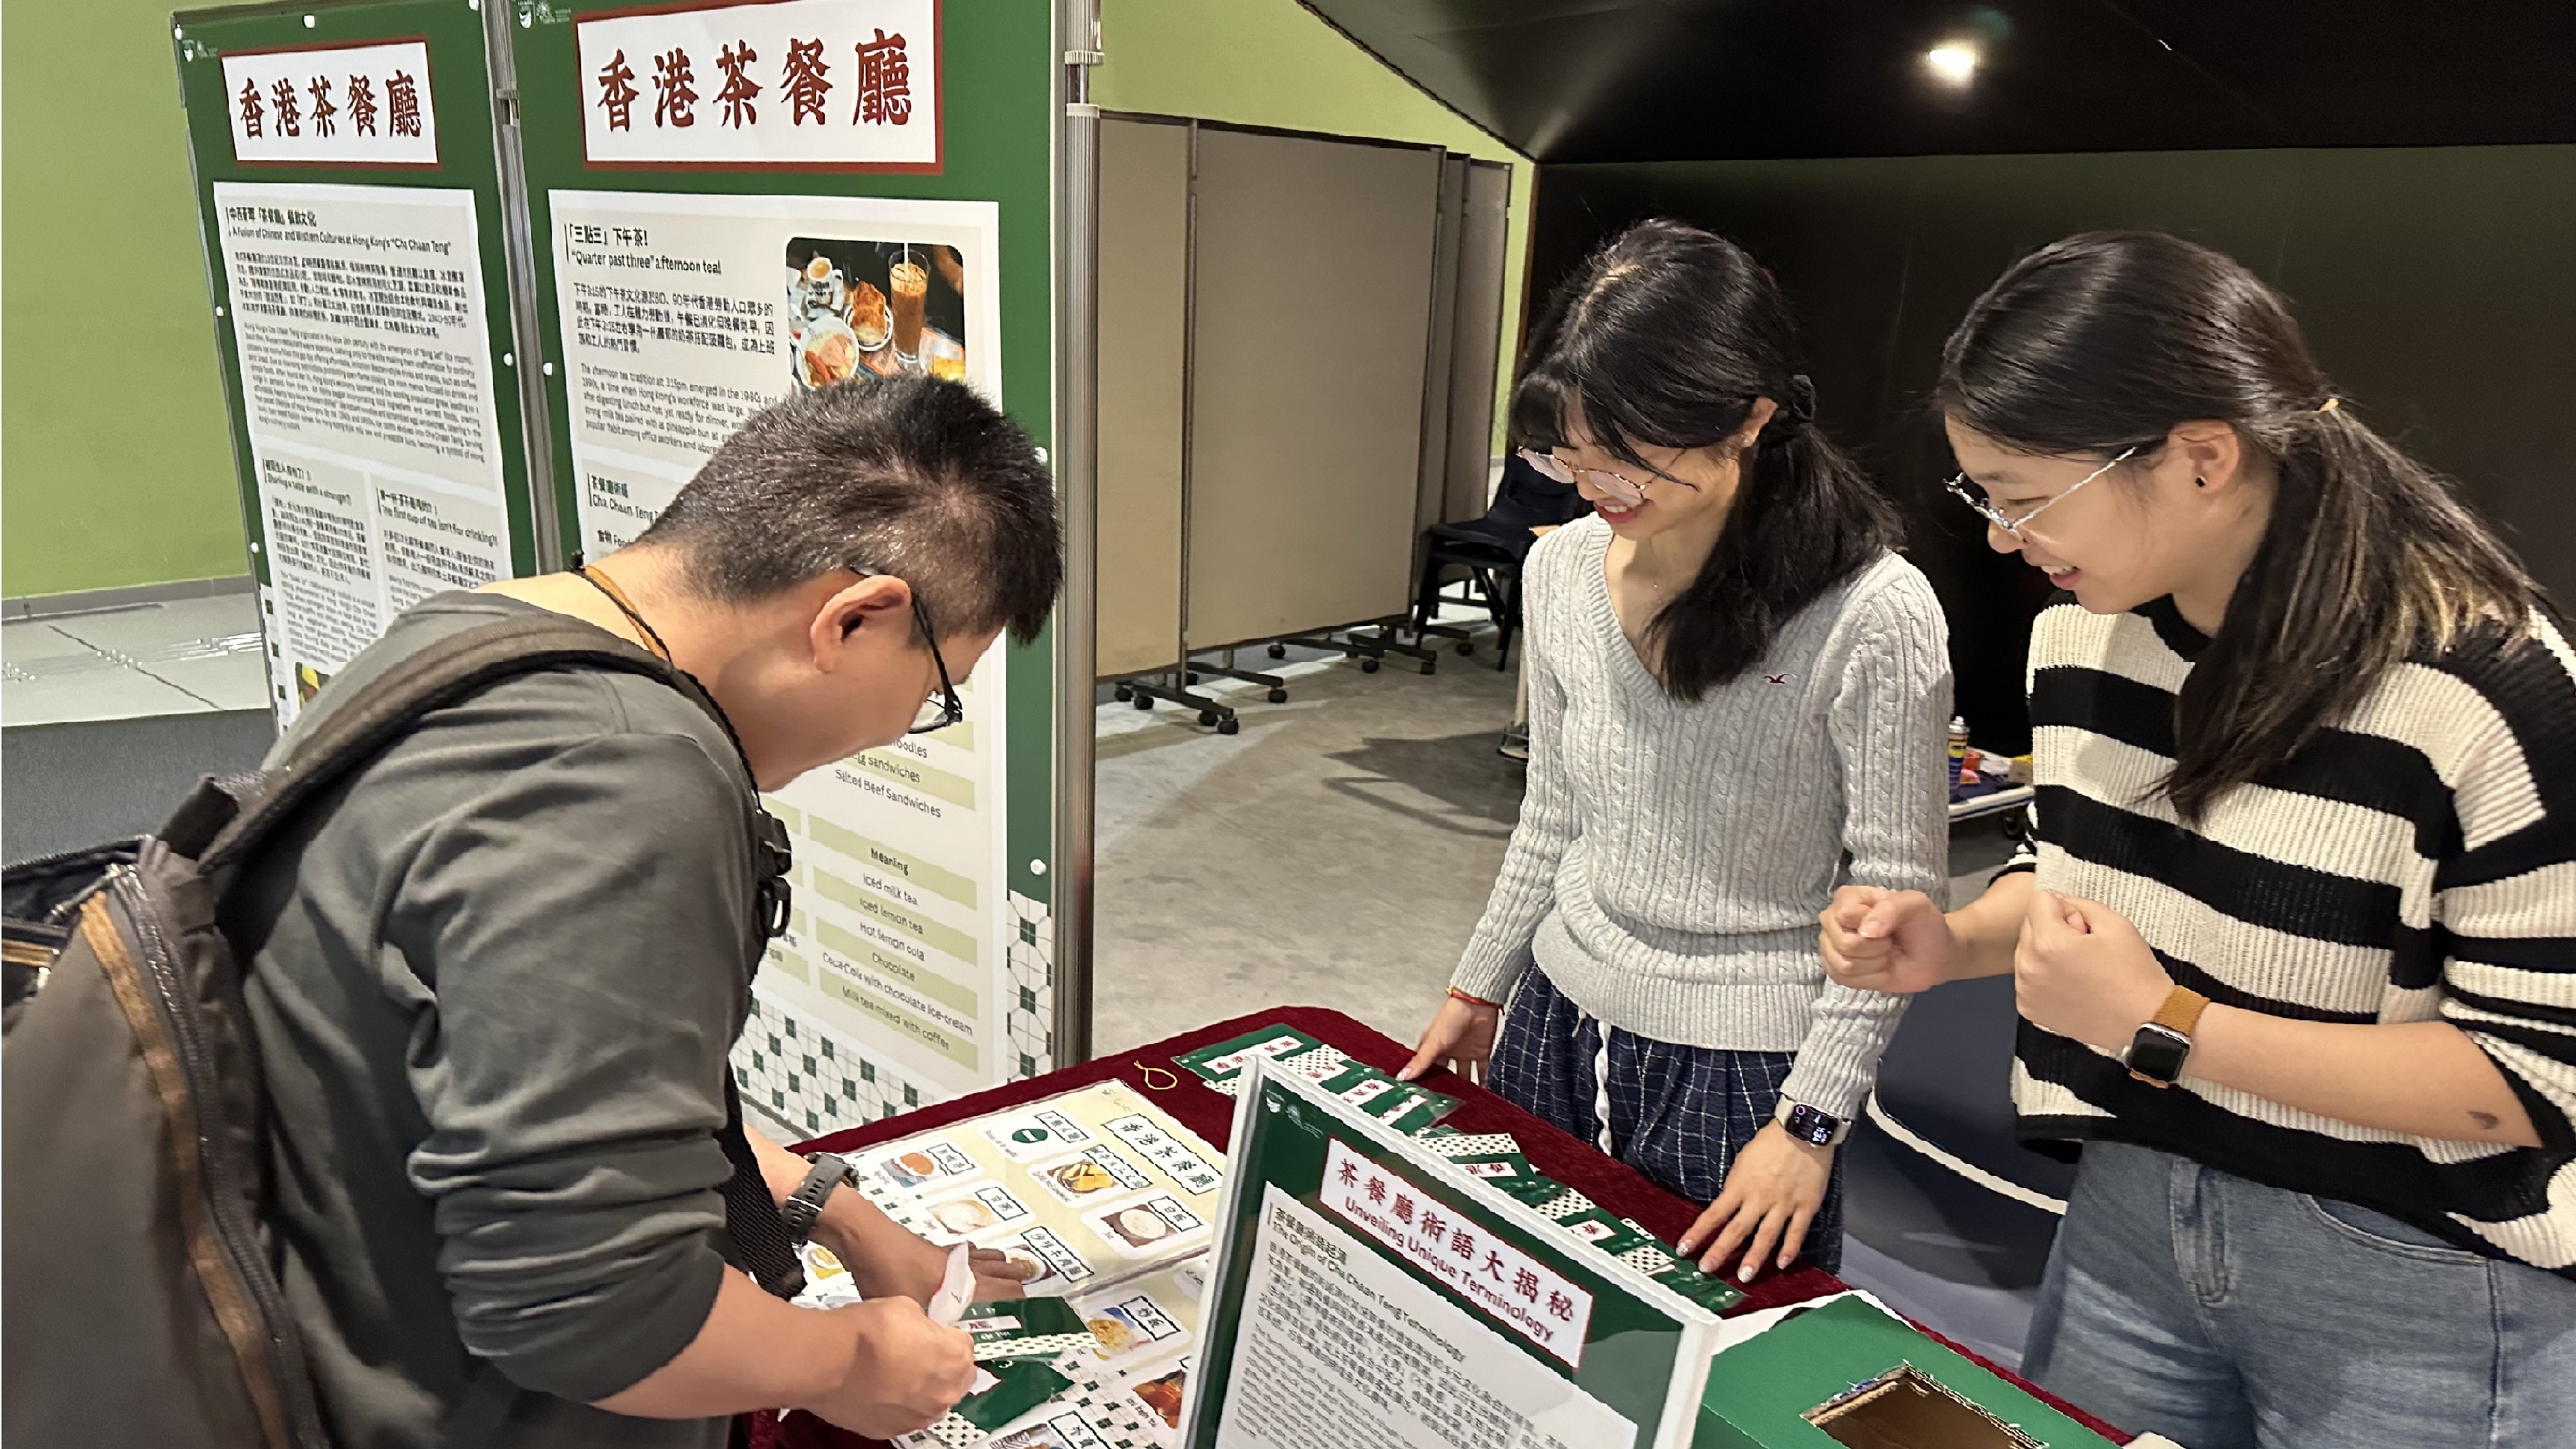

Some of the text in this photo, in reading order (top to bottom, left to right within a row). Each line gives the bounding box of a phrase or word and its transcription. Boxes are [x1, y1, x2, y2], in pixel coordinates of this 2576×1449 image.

[597, 28, 912, 132] 香港茶餐廳
[239, 70, 421, 138] 香港茶餐廳
[352, 233, 370, 250] Hong
[408, 239, 430, 253] Chaan
[609, 254, 625, 269] past
[655, 254, 700, 272] afternoon
[727, 387, 739, 399] the
[593, 494, 654, 524] Cha Chaan Teng
[868, 756, 920, 783] sandwiches
[835, 769, 942, 818] Salted Beef Sandwiches
[871, 848, 909, 876] Meaning
[863, 873, 918, 905] Iced milk tea
[860, 898, 924, 934] Iced lemon tea
[860, 922, 925, 961] Hot lemon cola
[872, 952, 916, 981] Chocolate
[860, 996, 874, 1011] tea
[875, 1004, 901, 1025] mixed
[903, 1018, 920, 1035] with
[922, 1029, 949, 1050] coffee
[864, 973, 883, 990] with
[884, 984, 926, 1012] chocolate
[927, 1004, 973, 1037] ice-cream
[1120, 1122, 1215, 1188] 香港茶餐廳
[1337, 1158, 1574, 1323] 茶餐廳術語大揭秘
[1273, 1221, 1289, 1240] The
[1328, 1260, 1346, 1280] Cha
[1378, 1294, 1403, 1321] Teng
[1345, 1195, 1555, 1344] Unveiling Unique Terminology
